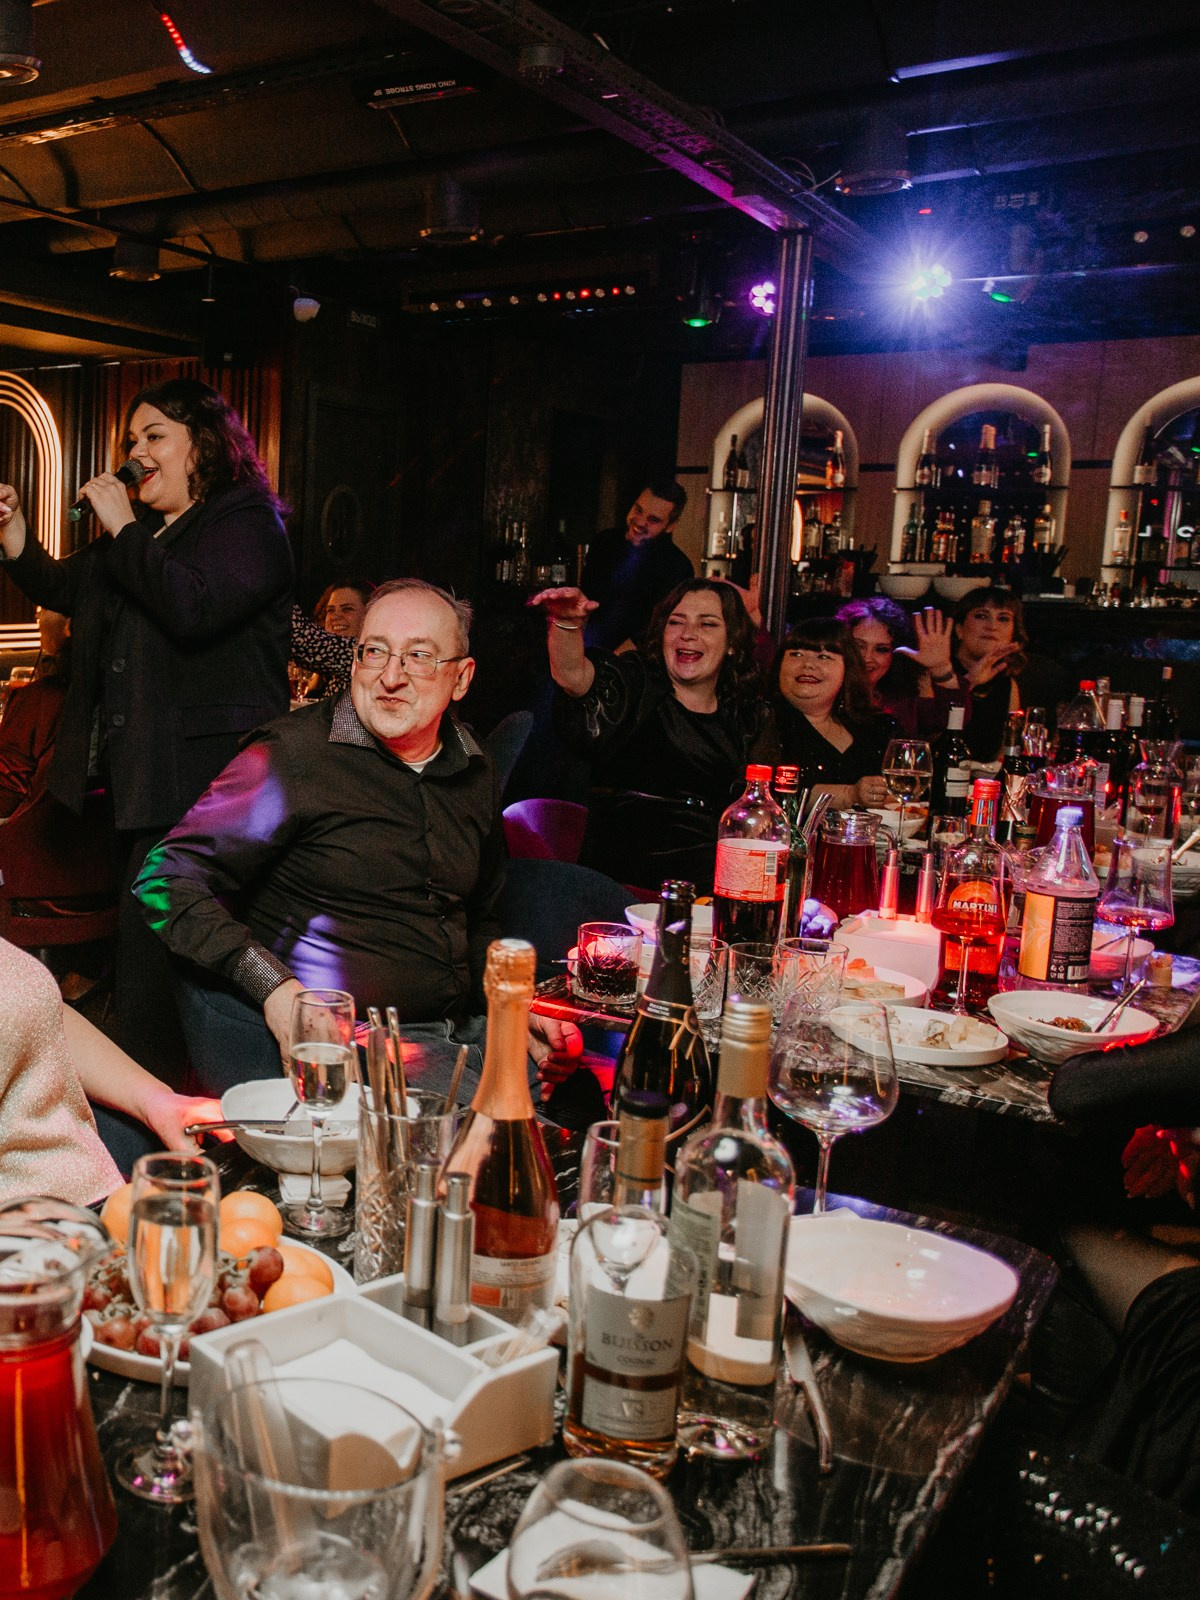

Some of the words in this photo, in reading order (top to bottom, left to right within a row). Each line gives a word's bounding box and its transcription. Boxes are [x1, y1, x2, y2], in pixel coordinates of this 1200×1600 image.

[385, 85, 415, 95] STROBE
[415, 83, 437, 91] KONG
[953, 900, 998, 914] MARTINI
